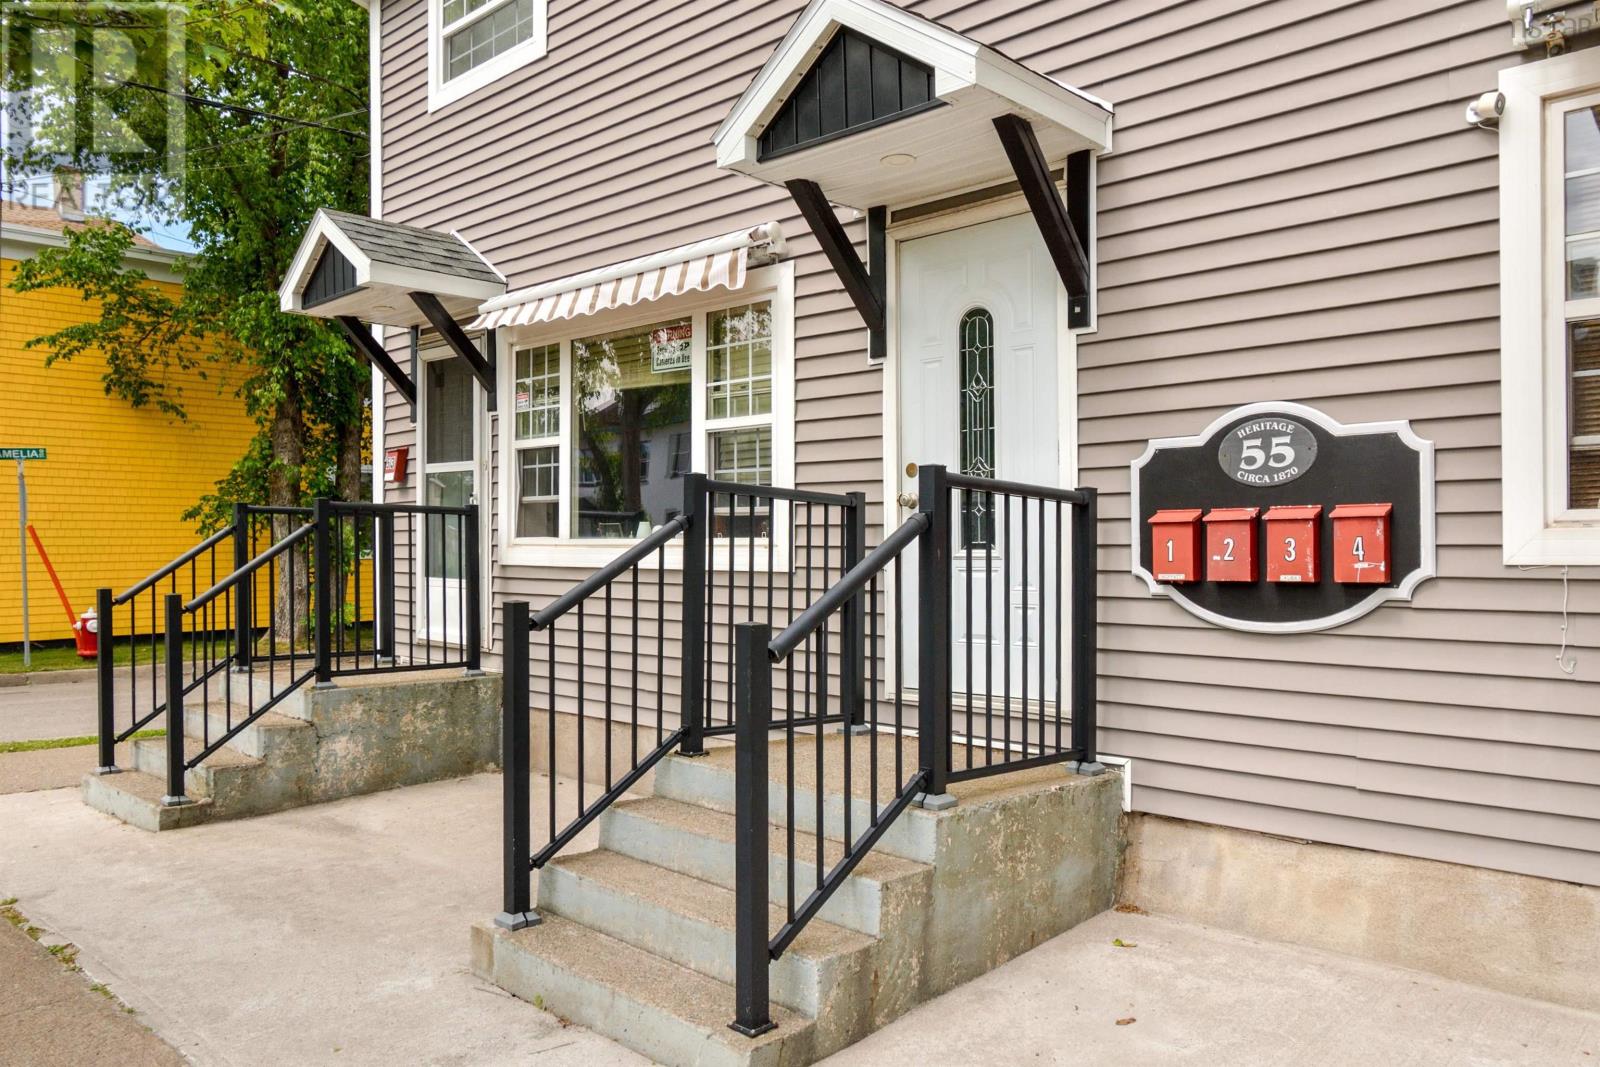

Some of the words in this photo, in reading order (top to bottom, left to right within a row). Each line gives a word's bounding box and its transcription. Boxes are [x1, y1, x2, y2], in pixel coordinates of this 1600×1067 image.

[1237, 421, 1295, 439] HERITAGE
[1239, 435, 1295, 470] 55
[1237, 470, 1270, 483] CIRCA
[1273, 466, 1299, 482] 1870
[1166, 539, 1174, 562] 1
[1223, 537, 1234, 561] 2
[1284, 537, 1296, 562] 3
[1352, 536, 1365, 562] 4
